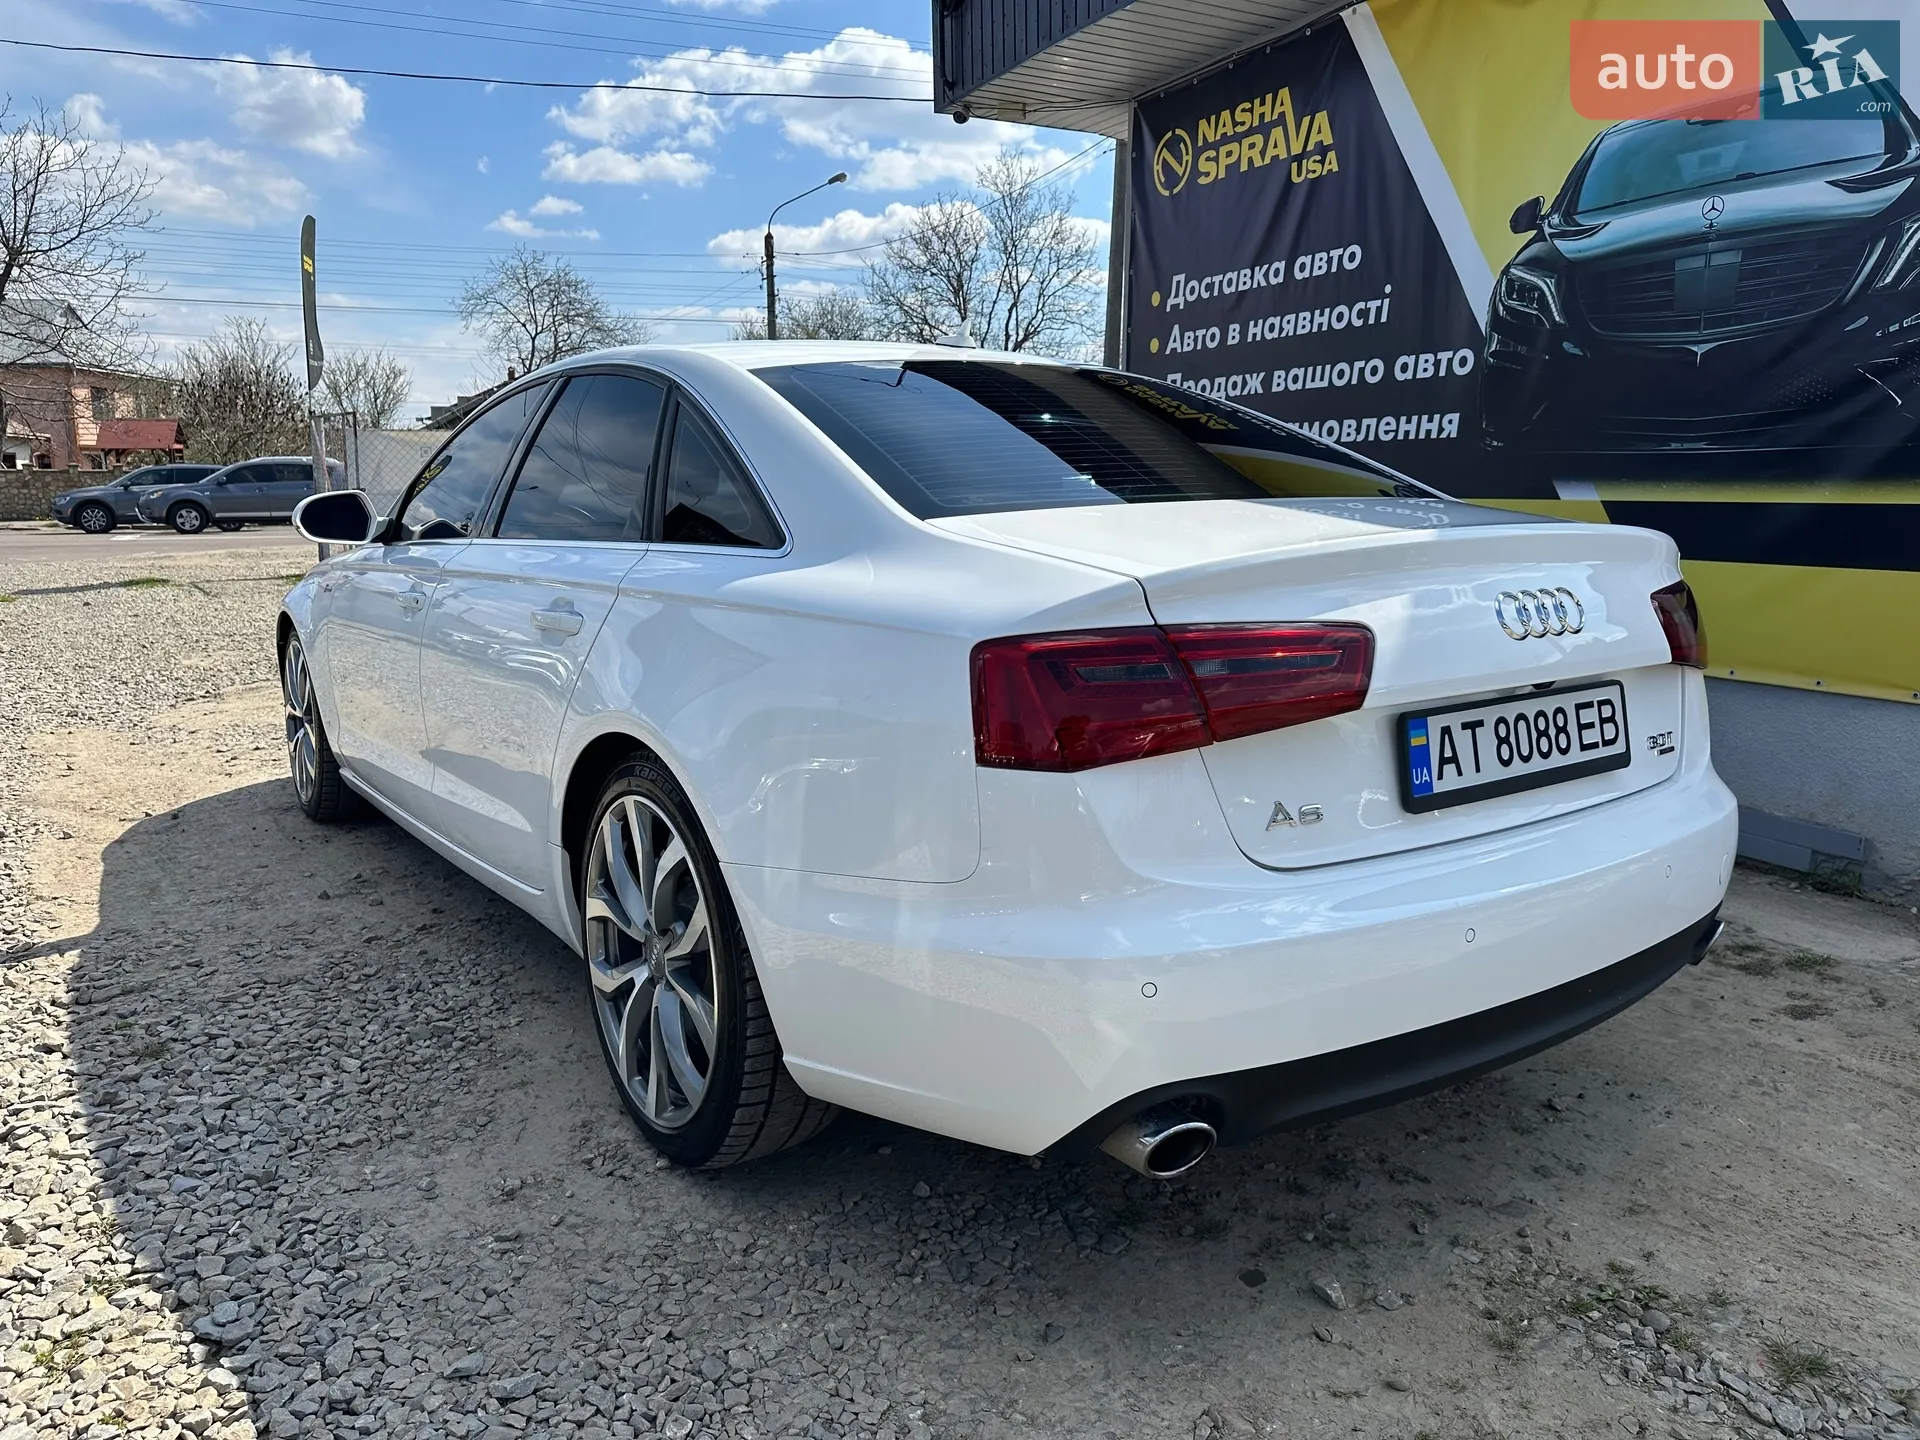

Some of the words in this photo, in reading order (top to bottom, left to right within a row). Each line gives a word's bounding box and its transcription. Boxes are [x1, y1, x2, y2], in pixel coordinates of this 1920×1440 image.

[1197, 86, 1291, 147] NASHA
[1197, 108, 1335, 185] SPRAVA
[1290, 150, 1340, 184] USA
[1166, 260, 1286, 312] Доставка
[1293, 244, 1362, 280] авто
[1165, 324, 1221, 355] Авто
[1226, 323, 1241, 346] в
[1247, 283, 1392, 343] наявності
[1271, 358, 1385, 394] вашого
[1393, 348, 1475, 381] авто
[1287, 412, 1461, 444] мовлення
[1436, 718, 1485, 781] AT
[1494, 706, 1572, 768] 8088
[1574, 698, 1620, 752] EB
[1412, 766, 1431, 785] UA
[1265, 800, 1324, 832] A6
